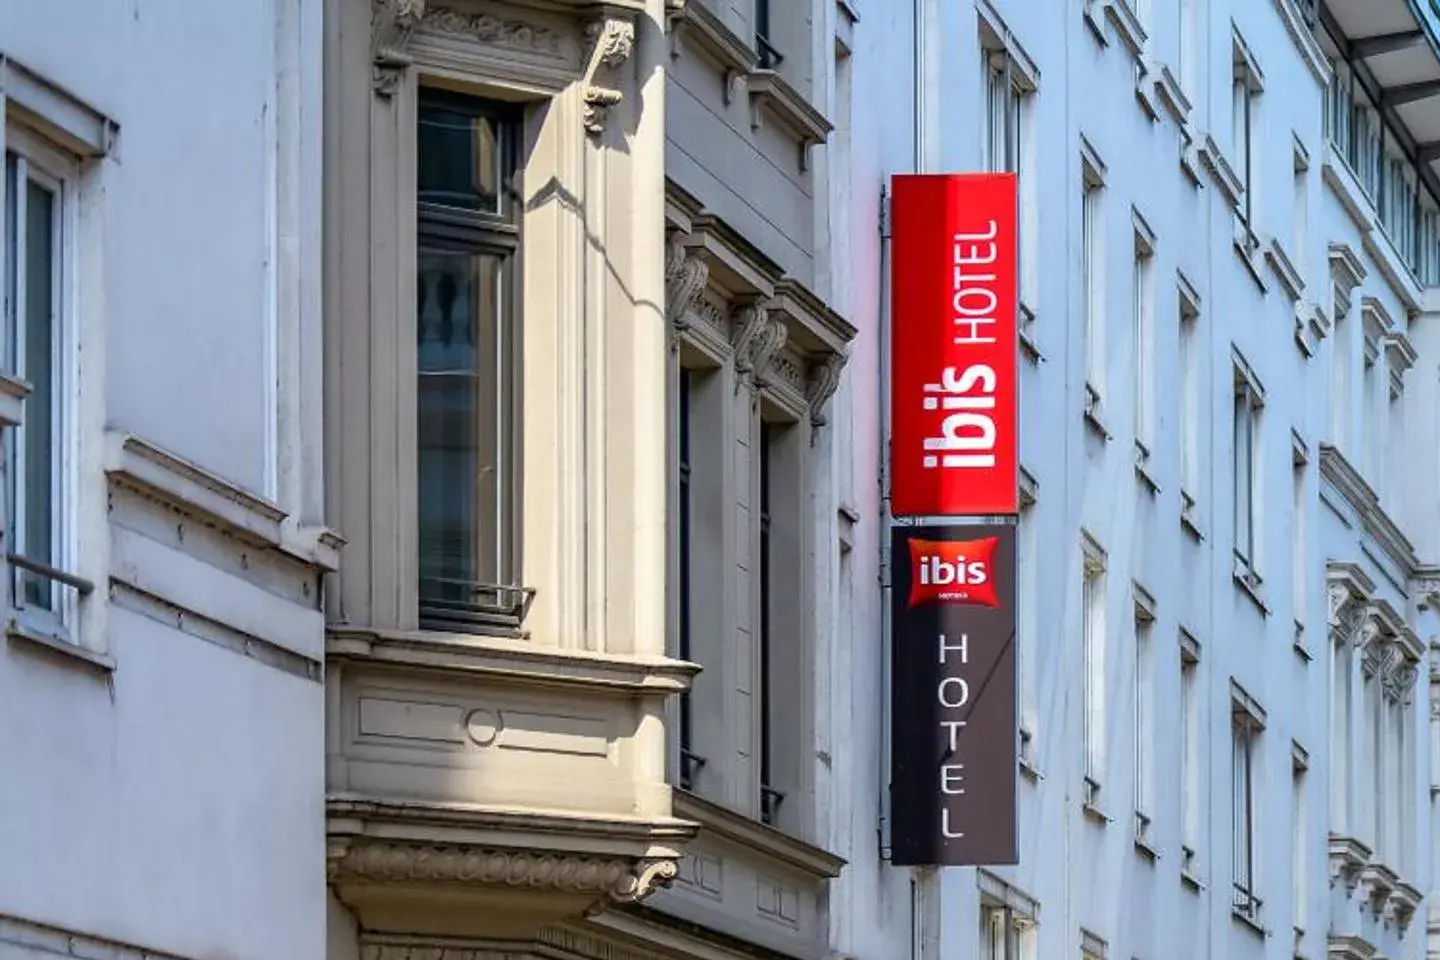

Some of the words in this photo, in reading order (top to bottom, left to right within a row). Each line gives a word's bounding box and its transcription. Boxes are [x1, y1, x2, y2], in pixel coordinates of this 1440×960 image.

[953, 219, 998, 344] HOTEL
[923, 363, 997, 468] ibis
[920, 555, 987, 585] ibis
[937, 633, 970, 839] HOTEL
